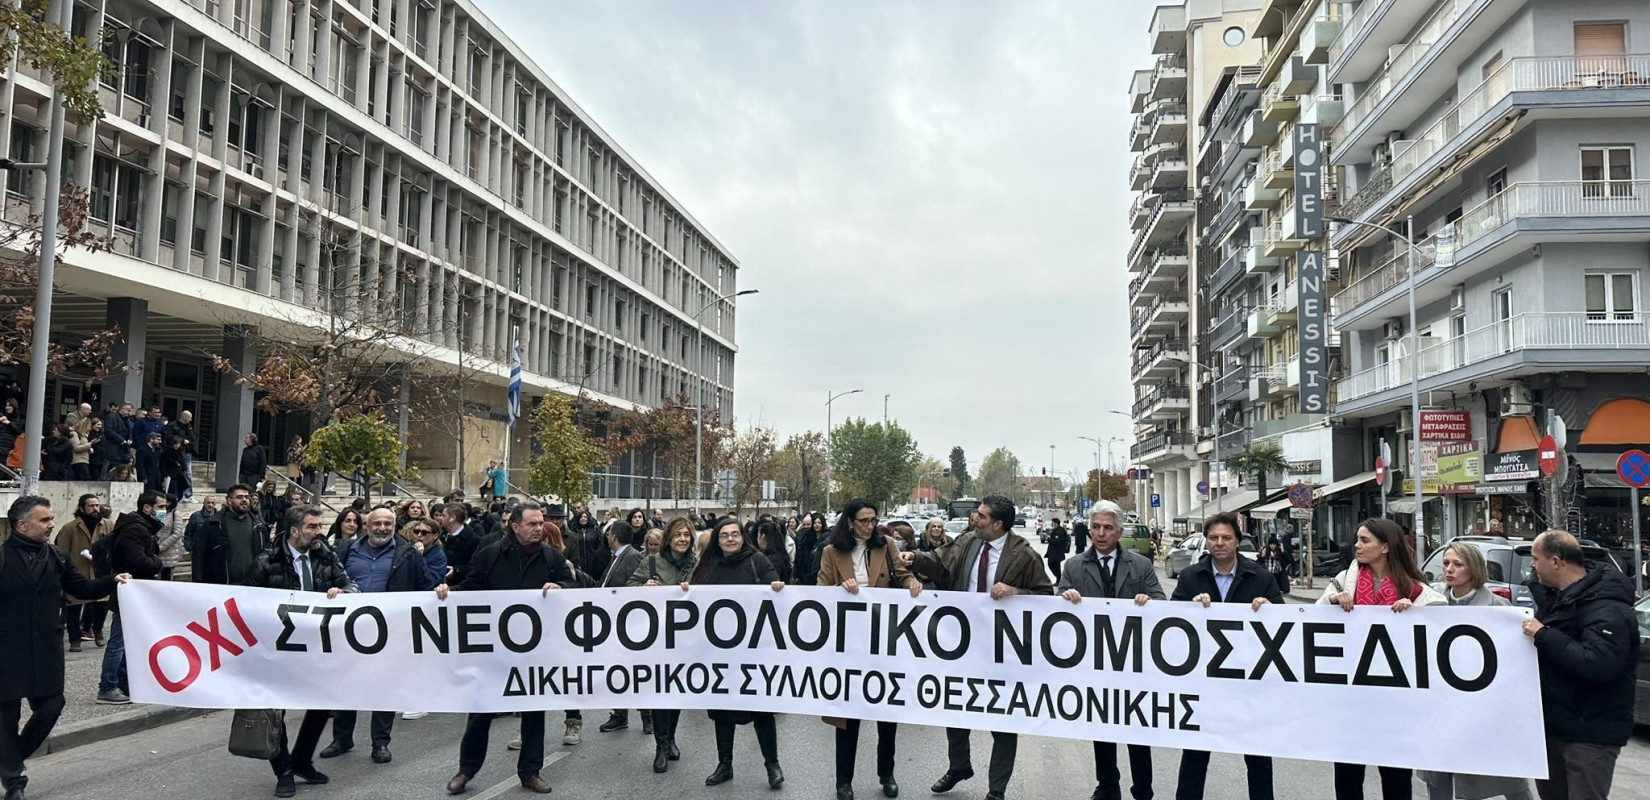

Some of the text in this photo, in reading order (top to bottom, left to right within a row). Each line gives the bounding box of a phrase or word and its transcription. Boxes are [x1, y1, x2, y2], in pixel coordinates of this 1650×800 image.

[1299, 125, 1322, 412] HOTEL ANESSIS
[1442, 443, 1473, 455] ΧΑΡΤΙΚΑ
[148, 597, 1498, 693] ΟΧΙ ΣΤΟ ΝΕΟ ΦΟΡΟΛΟΓΙΚΟ ΝΟΜΟΣΧΕΔΙΟ
[502, 662, 1200, 732] ΔΙΚΗΓΟΡΙΚΟΣ ΣΥΛΛΟΓΟΣ ΘΕΣΣΑΛΟΝΙΚΗΣ
